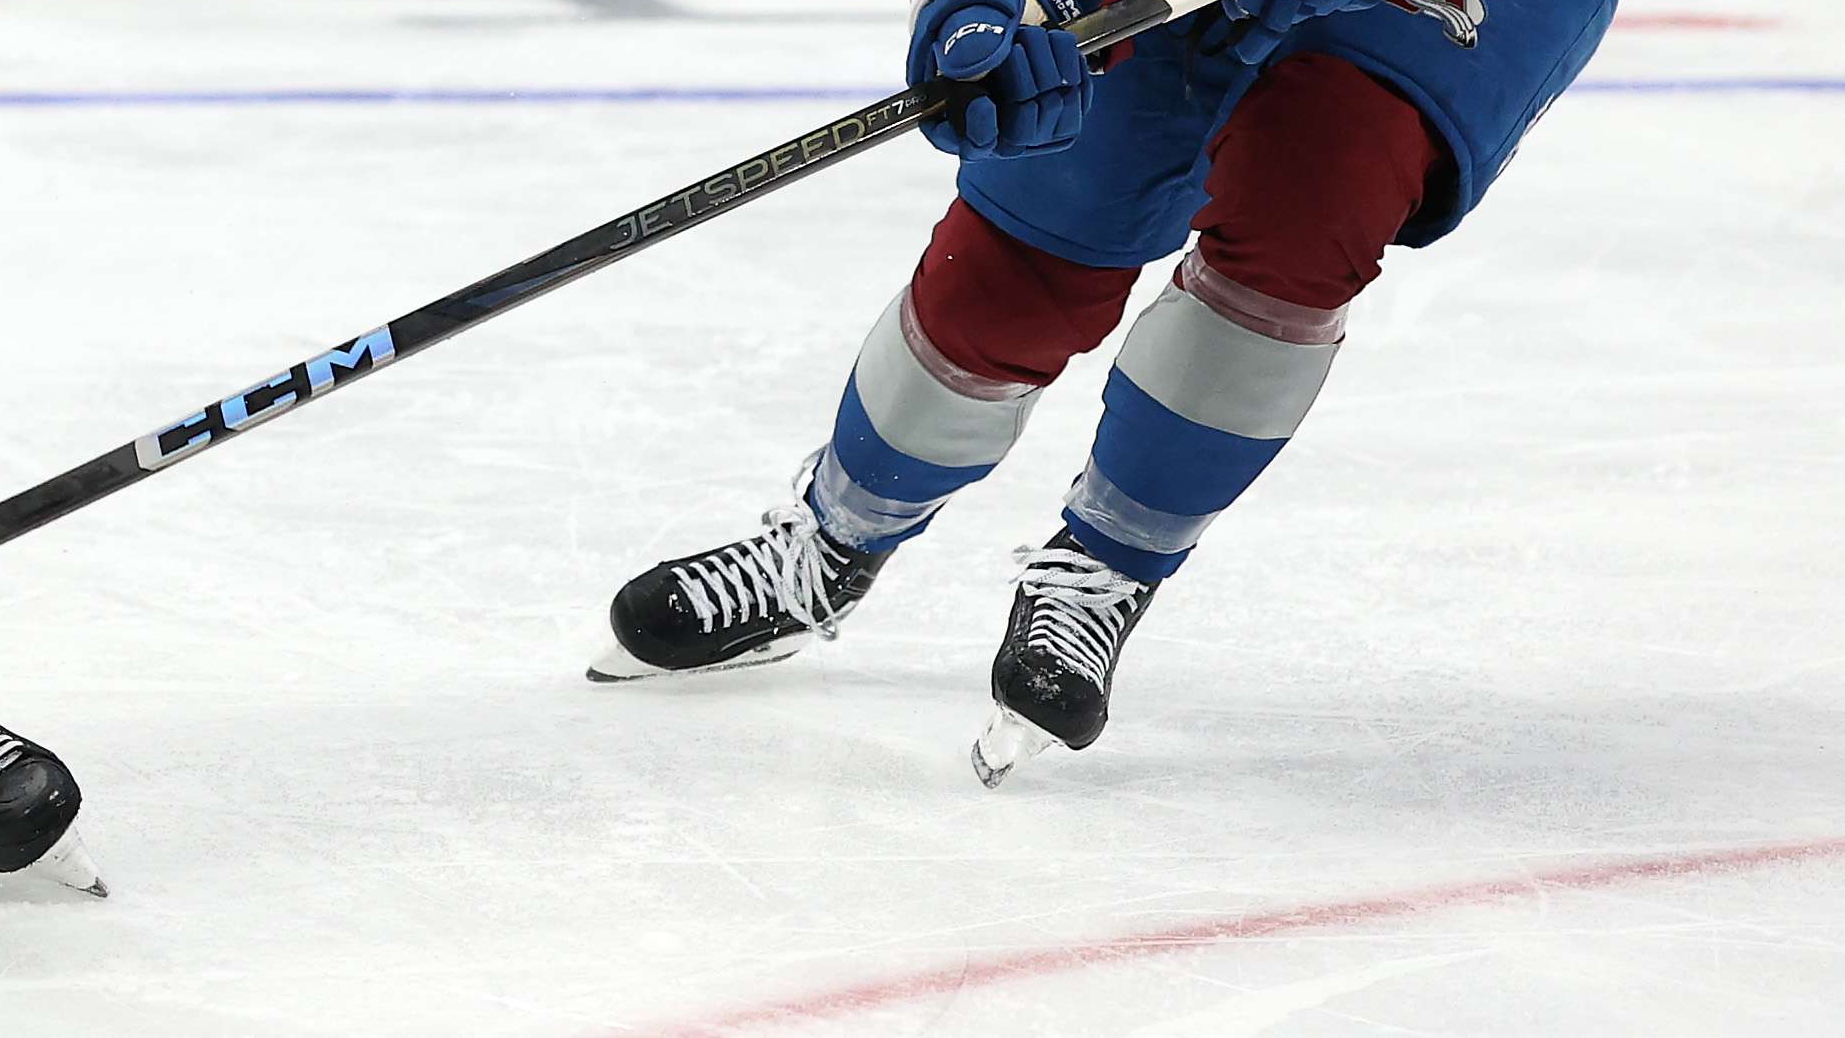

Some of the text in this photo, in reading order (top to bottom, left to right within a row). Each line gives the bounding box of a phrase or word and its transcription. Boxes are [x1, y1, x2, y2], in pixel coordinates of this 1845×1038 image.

[944, 23, 1004, 55] CCM
[609, 117, 867, 250] JETSPEED
[135, 324, 396, 470] CCM
